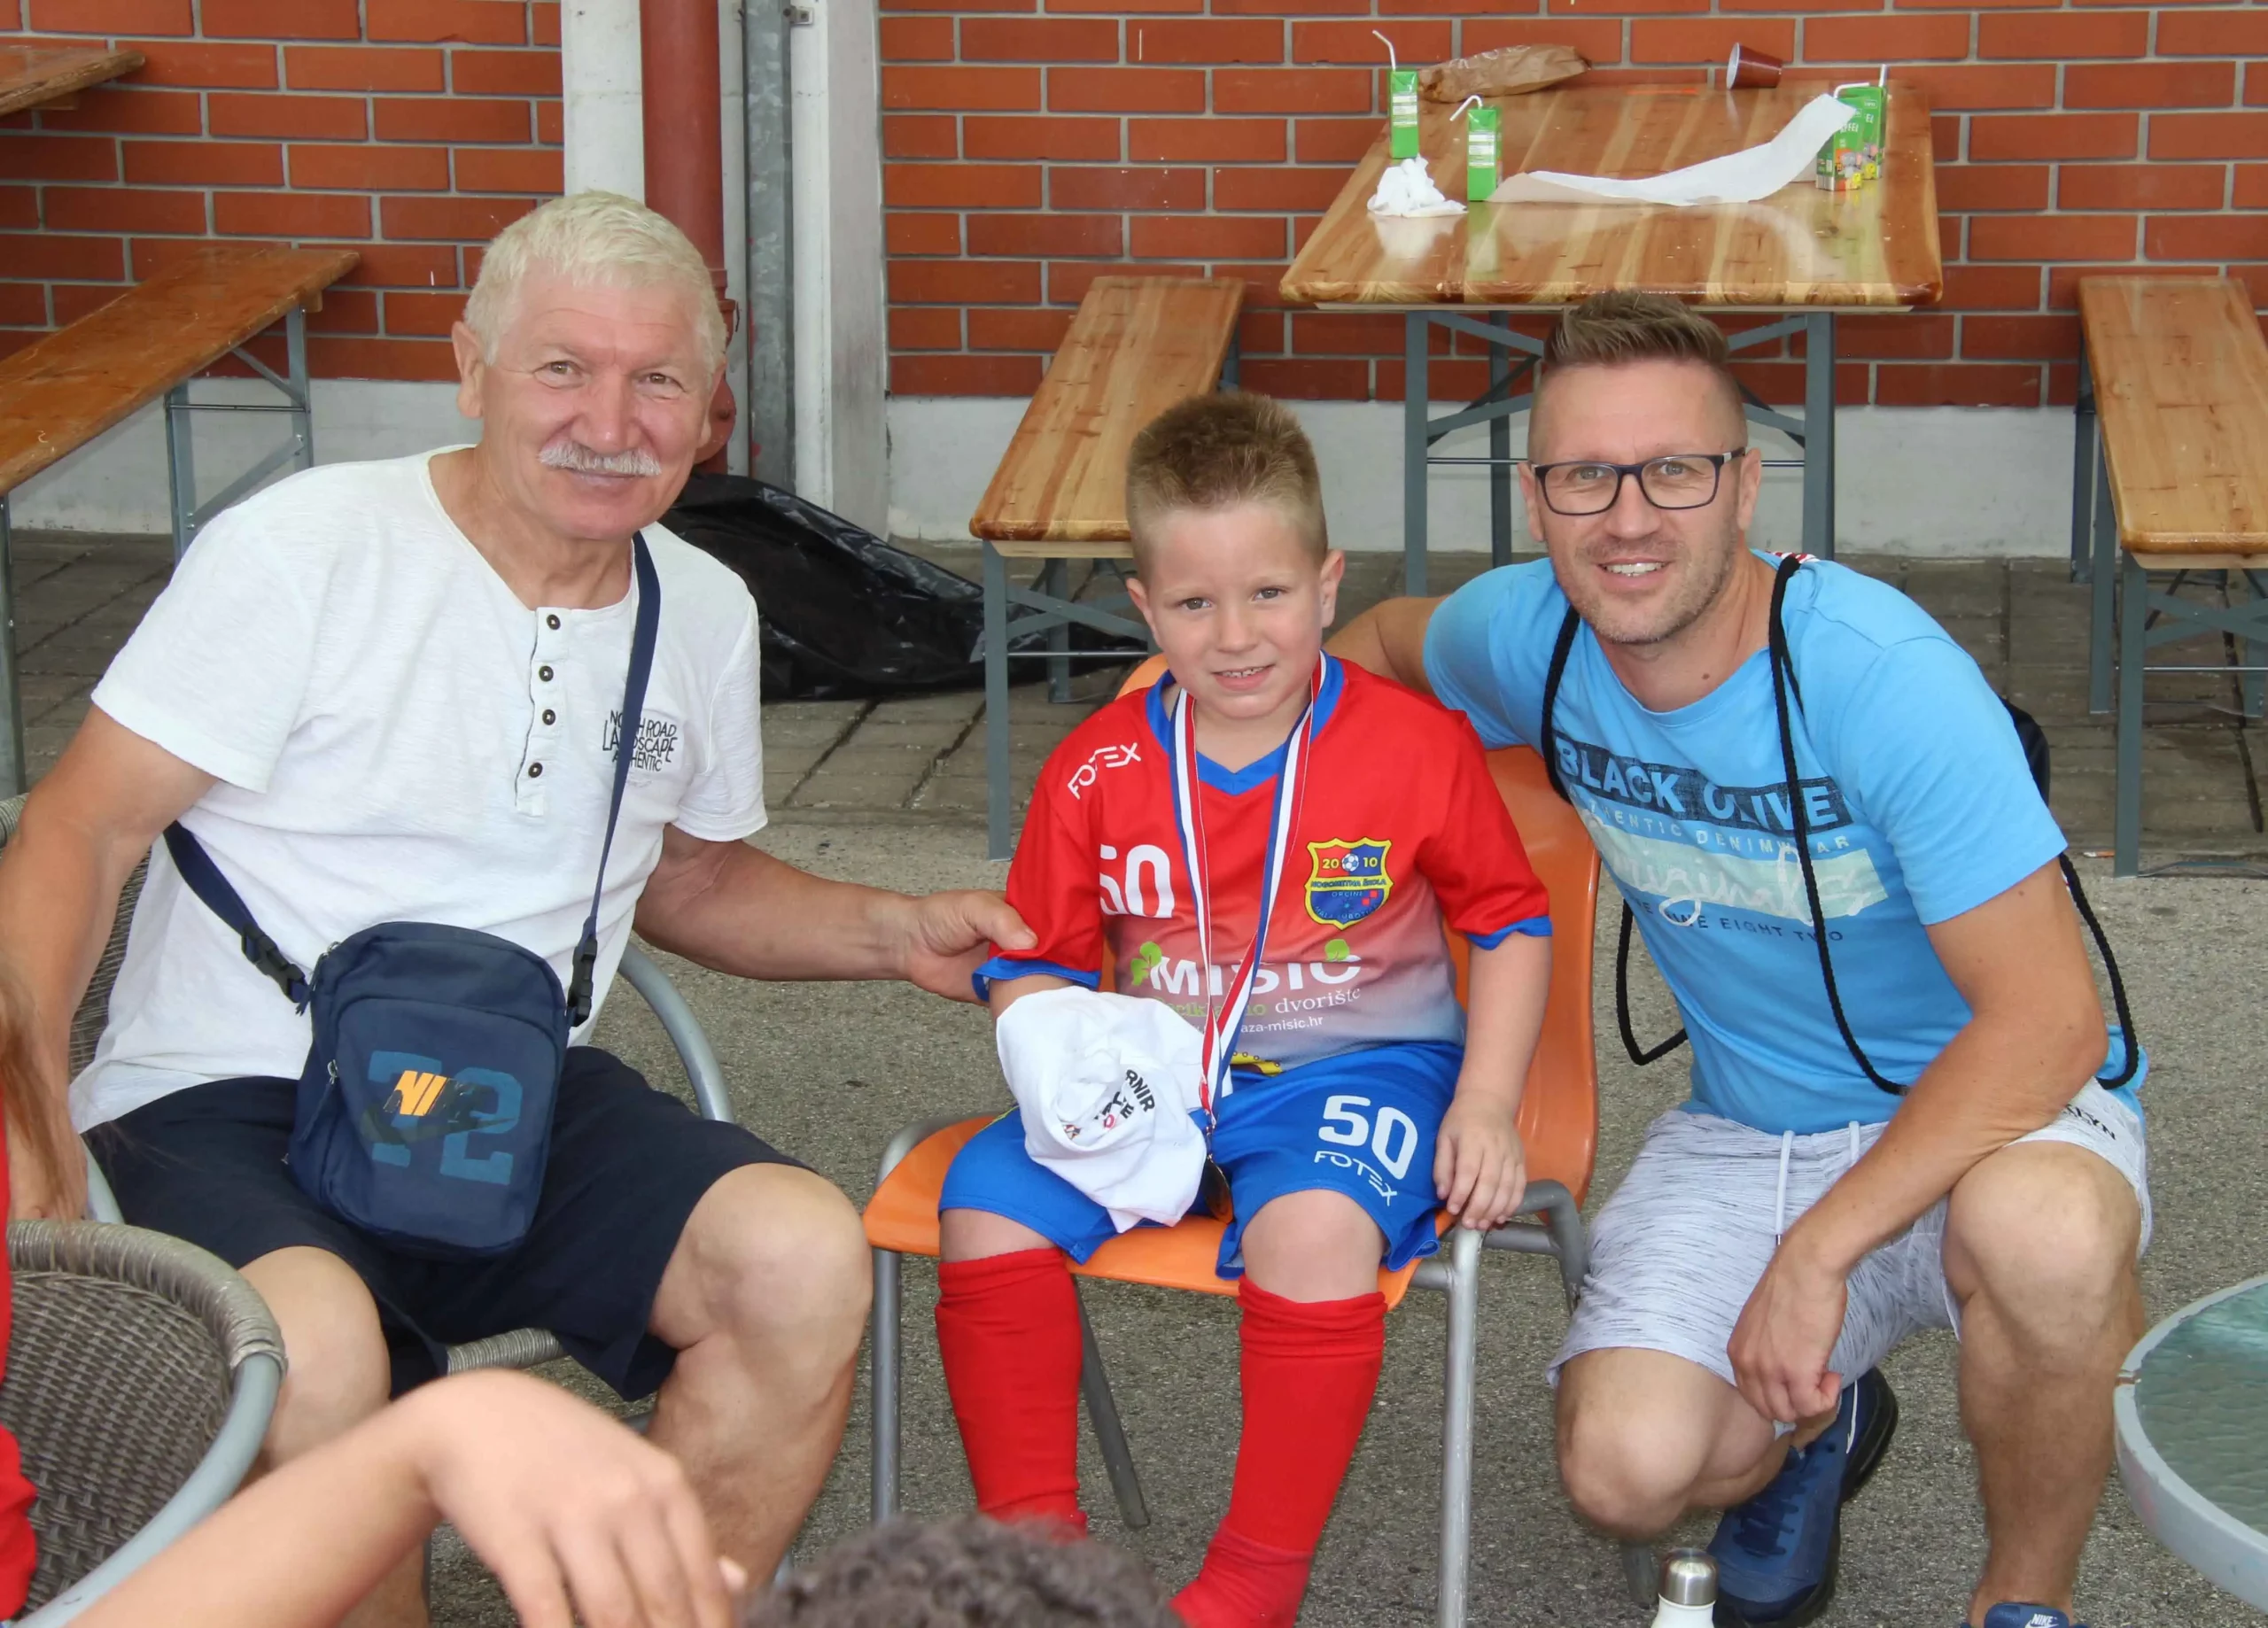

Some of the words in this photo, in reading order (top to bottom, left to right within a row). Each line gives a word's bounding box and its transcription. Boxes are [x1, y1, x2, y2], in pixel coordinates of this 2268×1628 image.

[646, 719, 678, 738] ROAD
[1555, 736, 1685, 813] BLACK
[1322, 857, 1340, 869] 20
[1363, 857, 1379, 868] 10
[1719, 918, 1783, 937] EIGHT
[1275, 988, 1362, 1015] dvorište
[1318, 1095, 1418, 1180] 50
[1314, 1151, 1397, 1206] FOTEX
[2031, 1613, 2054, 1626] NIKE
